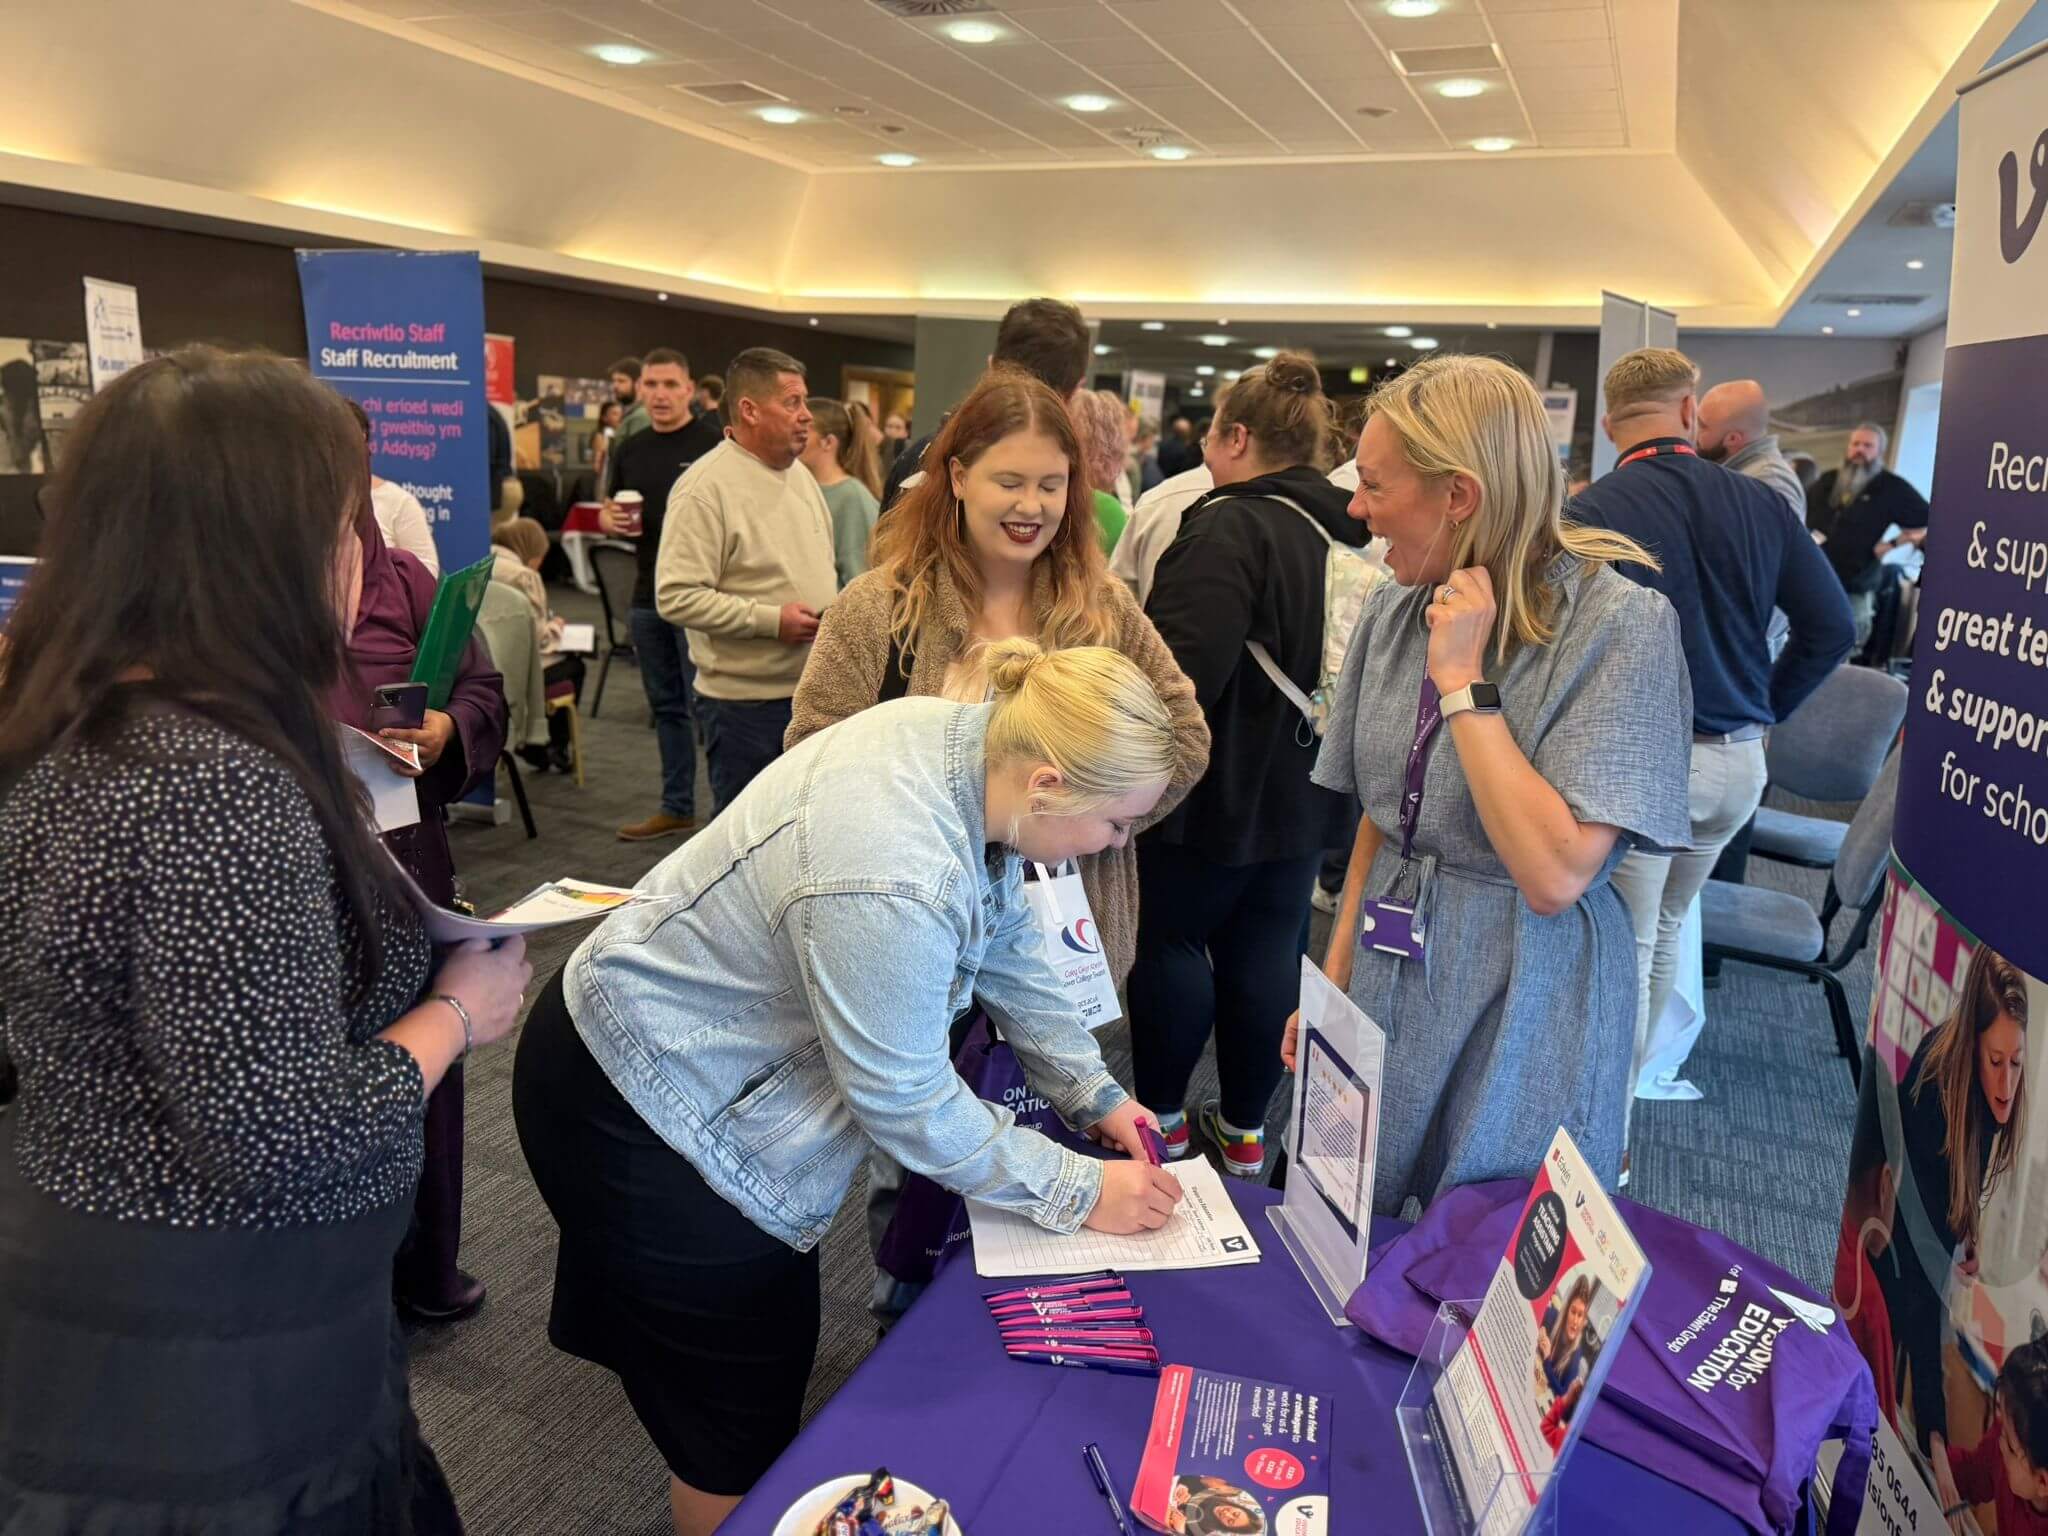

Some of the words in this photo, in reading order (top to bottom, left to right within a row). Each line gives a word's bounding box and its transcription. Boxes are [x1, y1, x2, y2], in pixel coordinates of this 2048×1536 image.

[330, 321, 404, 342] Recriwtio
[408, 322, 445, 343] Staff
[321, 347, 358, 367] Staff
[362, 349, 458, 370] Recruitment
[362, 398, 381, 412] chi
[386, 399, 428, 415] erioed
[431, 400, 463, 416] wedi
[380, 420, 435, 437] gweithio
[439, 425, 461, 440] ym
[382, 440, 436, 460] Addysg?
[438, 506, 450, 520] in
[1967, 521, 1988, 569] &
[1993, 537, 2048, 595] sup
[1935, 607, 2014, 656] great
[2017, 617, 2048, 668] te
[1926, 669, 1945, 714] &
[1948, 688, 2048, 757] suppor
[1941, 751, 1980, 806] for
[1538, 1202, 1561, 1246] TEACHING
[1533, 1216, 1555, 1257] ASSISTANT
[1708, 1297, 1730, 1314] The
[1692, 1310, 1717, 1332] Edwin
[1666, 1330, 1698, 1353] Group
[1687, 1303, 1771, 1393] EDUCATION
[1726, 1369, 1757, 1391] for
[1264, 1405, 1276, 1423] both
[1887, 1465, 1917, 1532] 0644
